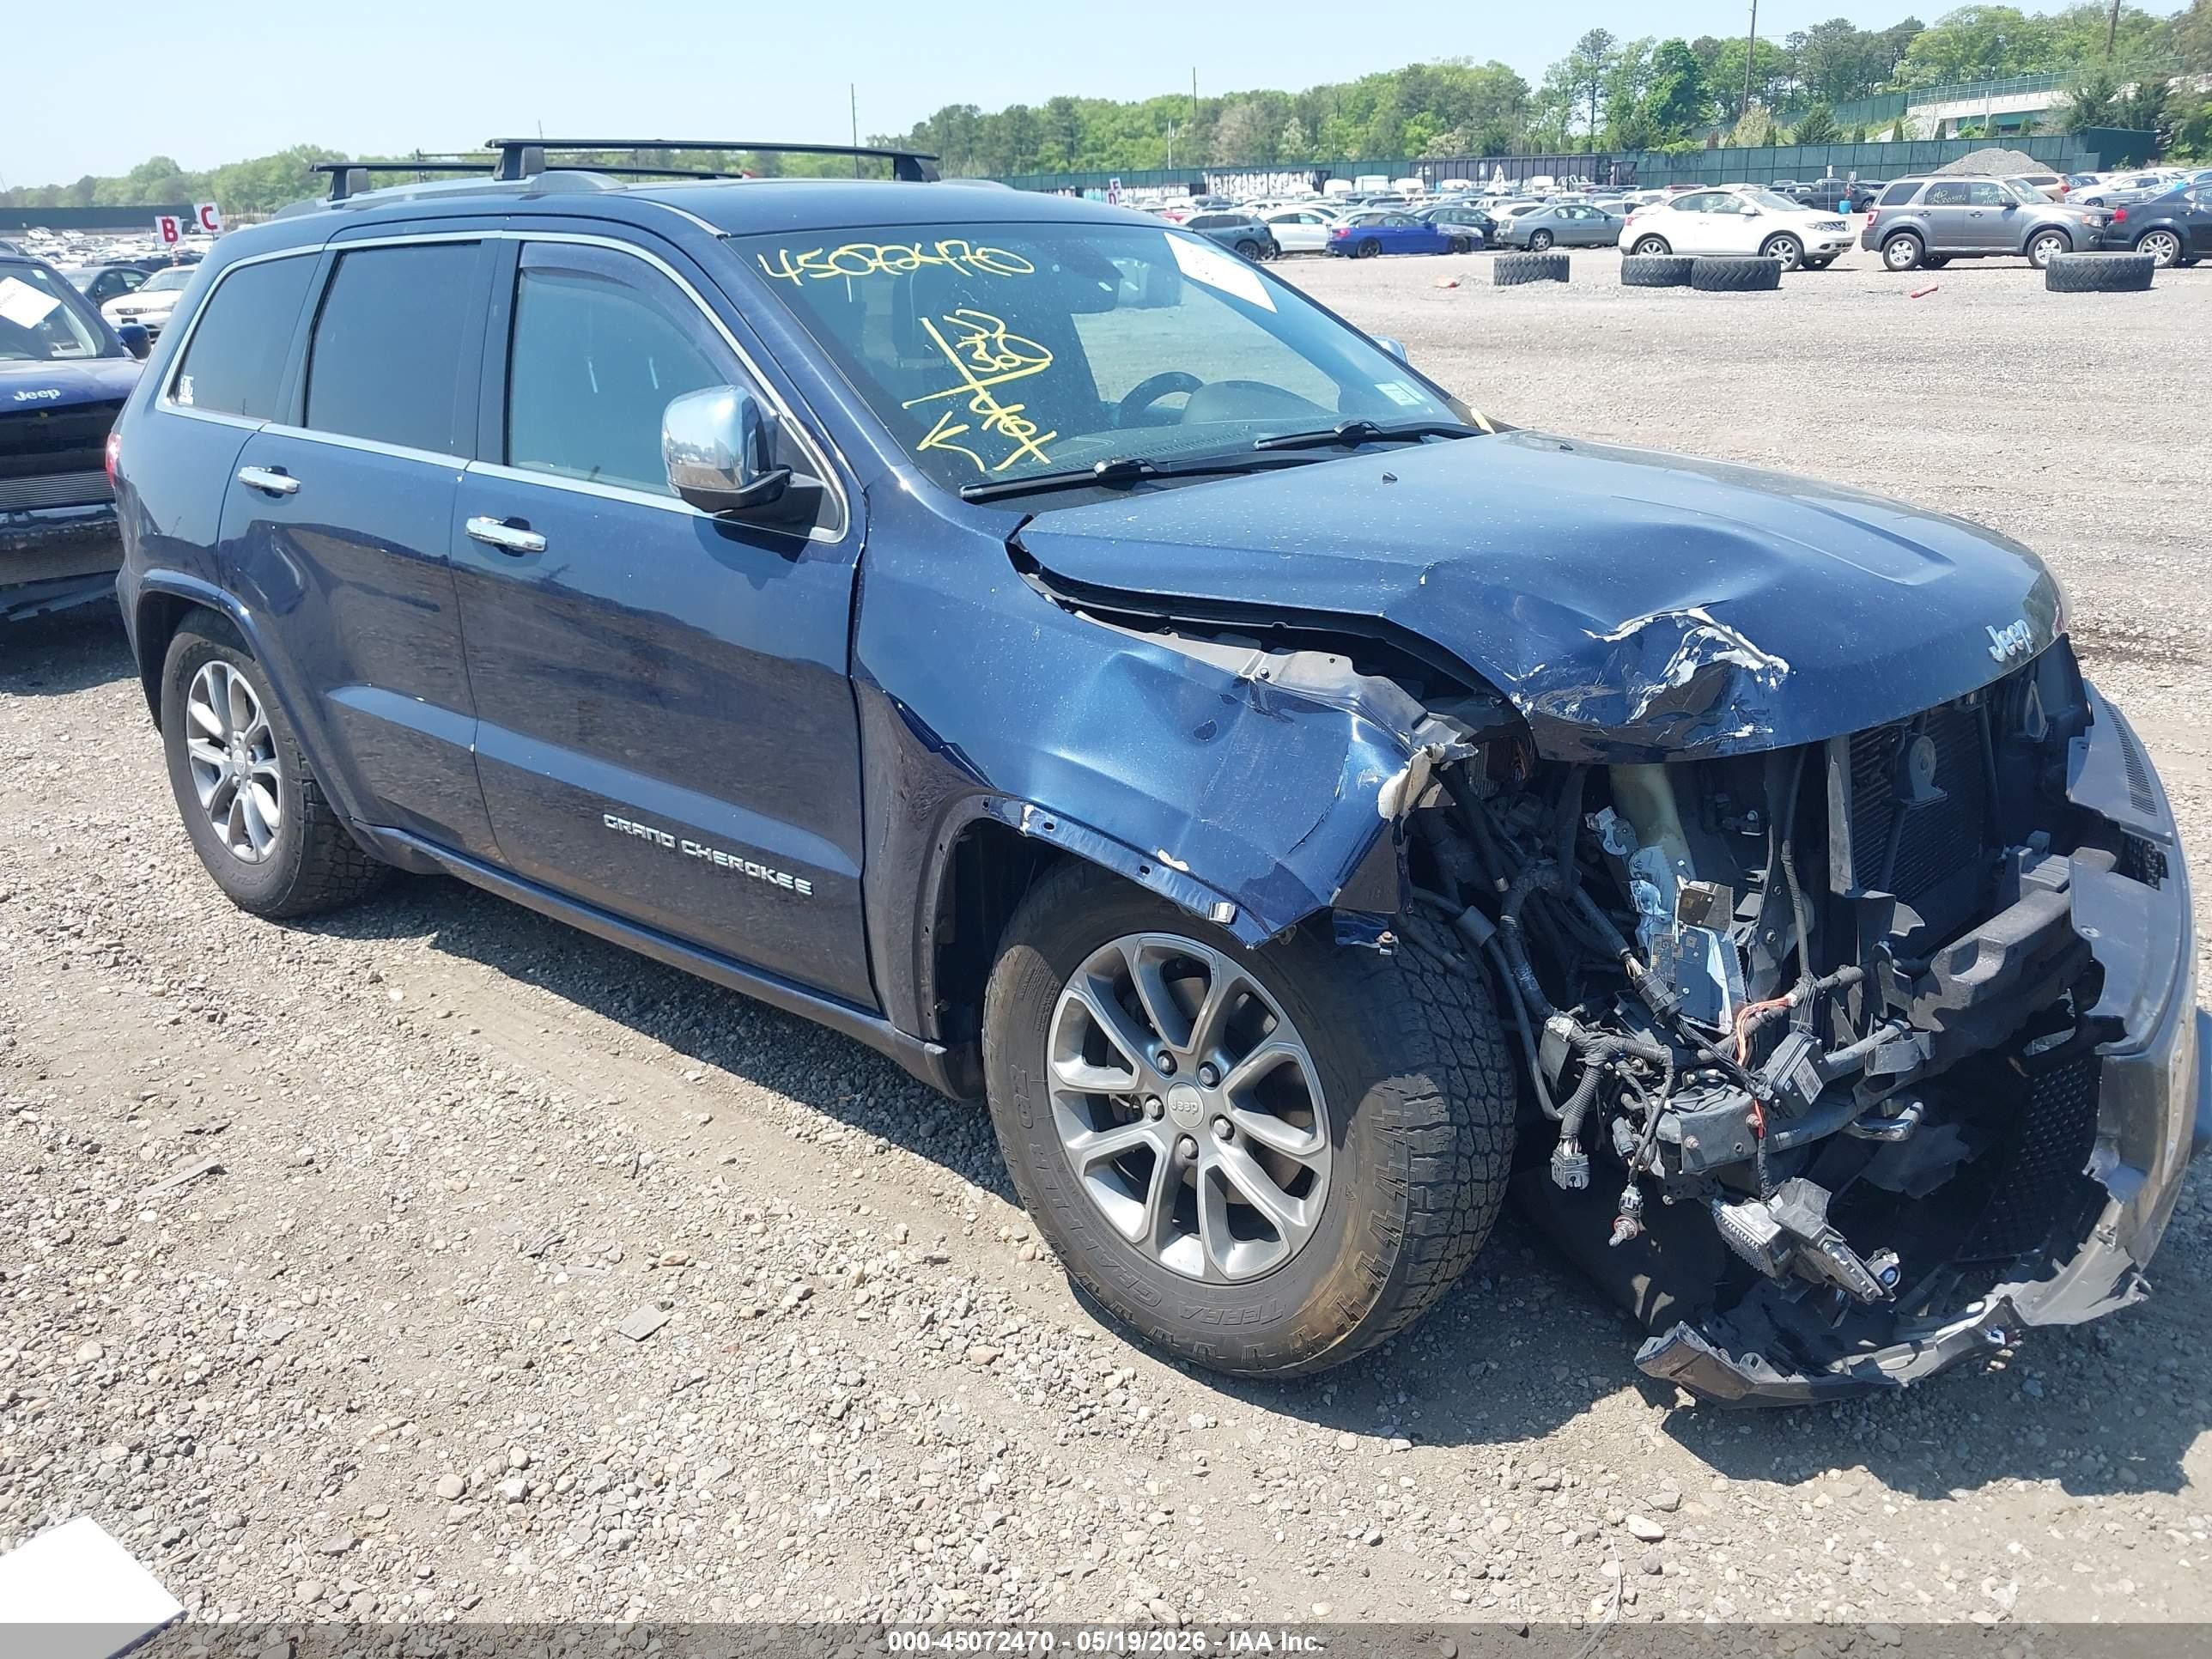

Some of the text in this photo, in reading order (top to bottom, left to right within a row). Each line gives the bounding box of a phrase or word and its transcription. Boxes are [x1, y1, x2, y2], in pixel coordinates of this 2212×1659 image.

[161, 217, 179, 242] B
[201, 206, 218, 230] C
[13, 388, 62, 402] Jeep
[1985, 618, 2034, 662] Jeep
[603, 813, 814, 896] GRAND CHEROKEE
[1170, 1097, 1200, 1115] Jeep
